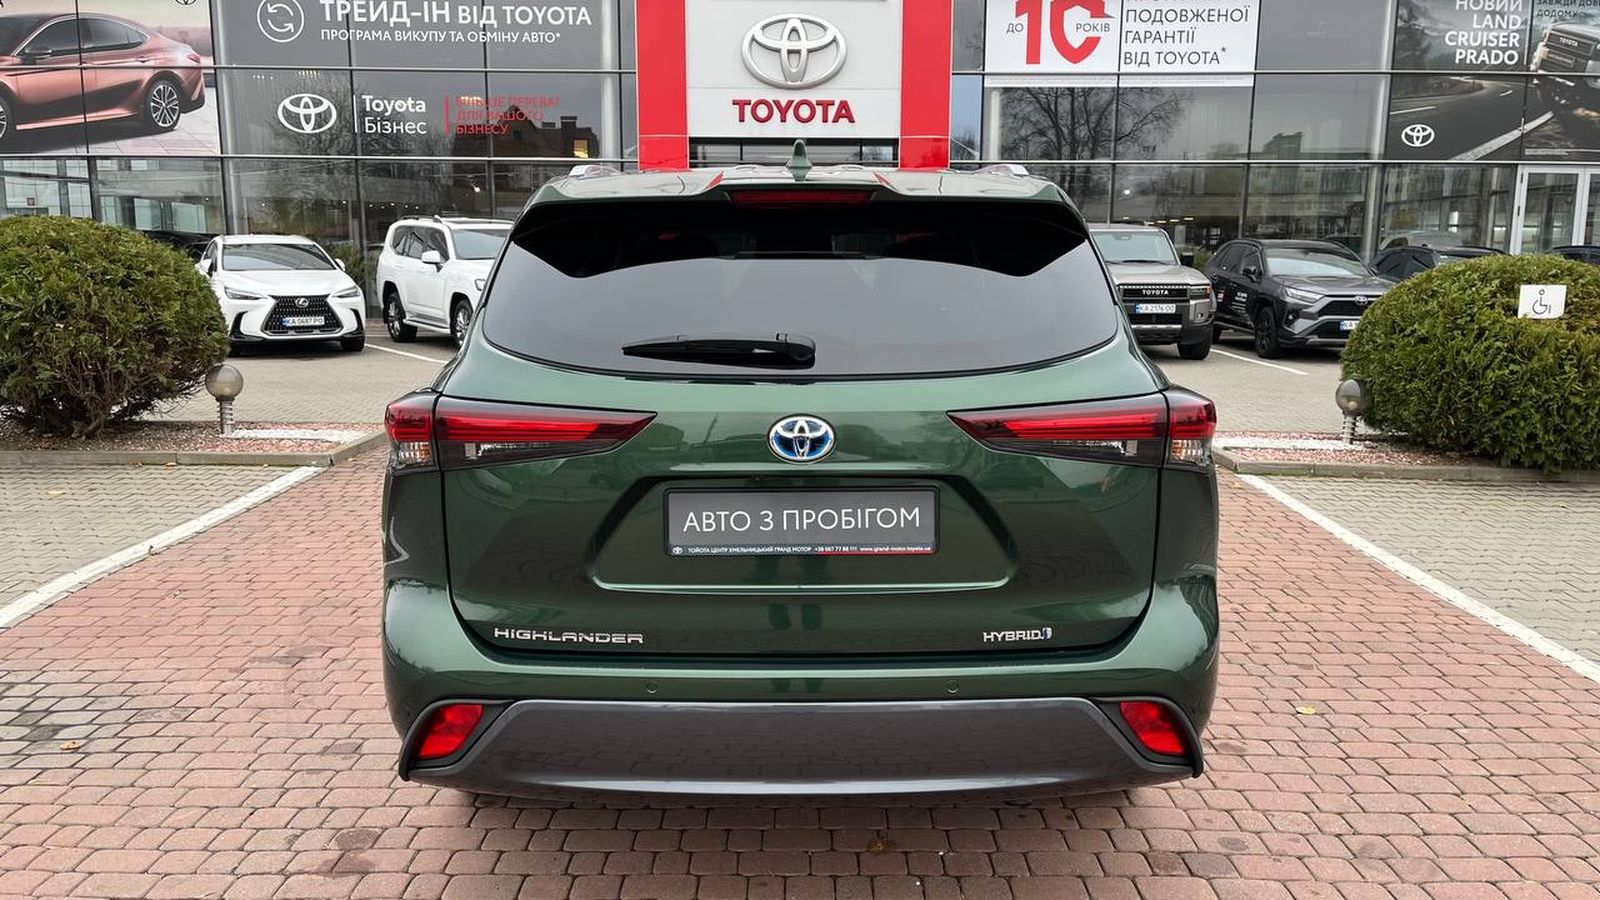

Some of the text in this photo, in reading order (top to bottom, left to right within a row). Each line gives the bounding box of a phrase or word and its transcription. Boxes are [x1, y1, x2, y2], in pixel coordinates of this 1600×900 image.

[457, 5, 498, 28] ВІД
[501, 5, 592, 25] TOYOTA
[1125, 5, 1251, 25] ПОДОВЖЕНОЇ
[1472, 14, 1522, 30] LAND
[320, 29, 392, 41] ПРОГРАМА
[394, 30, 447, 42] ВИКУПУ
[449, 31, 465, 42] ТА
[467, 31, 520, 43] ОБМІНУ
[1006, 22, 1111, 34] ДО РОКІВ
[1124, 26, 1197, 44] ГАРАНТІЇ
[1444, 31, 1520, 47] CRUISER
[1123, 51, 1151, 68] ВІД
[1455, 49, 1519, 65] PRADO
[361, 95, 427, 116] Toyota
[732, 98, 856, 124] TOYOTA
[364, 116, 427, 134] Бізнес
[682, 507, 920, 533] АВТО З ПРОБІГОМ
[494, 627, 644, 644] HIGHLANDER
[982, 629, 1042, 643] HYBRID
